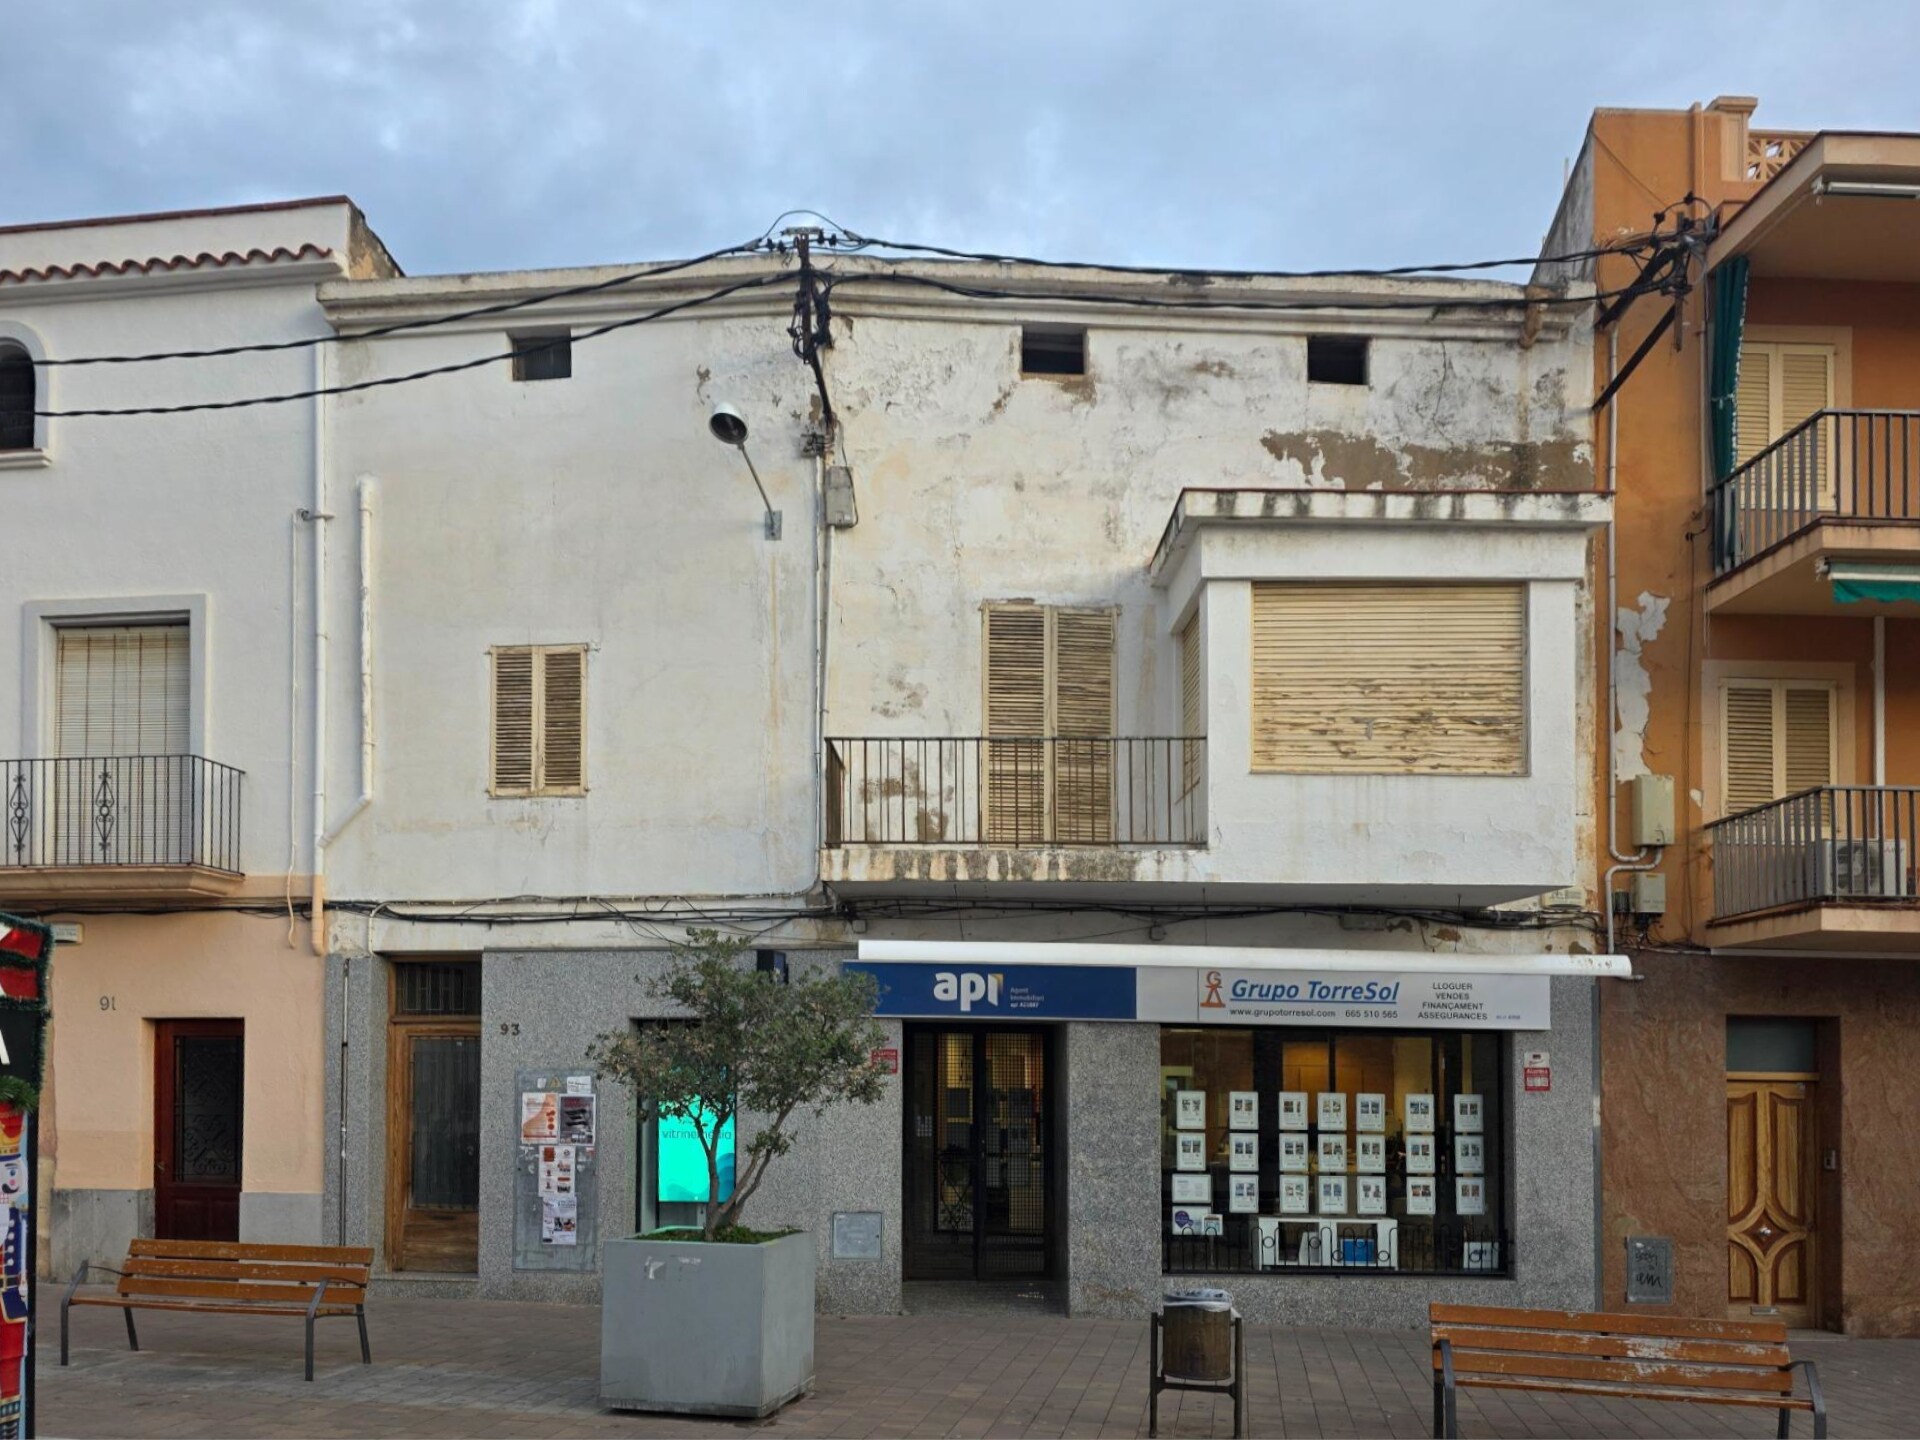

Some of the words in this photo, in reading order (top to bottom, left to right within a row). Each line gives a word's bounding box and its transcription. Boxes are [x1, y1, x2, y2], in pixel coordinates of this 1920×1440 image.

[1232, 979, 1299, 1001] Grupo
[1308, 981, 1400, 1000] TorreSol
[1432, 982, 1473, 990] LLOGUER
[933, 972, 1003, 1011] api
[1435, 992, 1470, 1000] VENDES
[99, 996, 116, 1011] 91
[1422, 1001, 1484, 1010] FINANÇAMENT
[1230, 1008, 1336, 1018] www.grupotorresol.com
[1345, 1009, 1361, 1018] 665
[1364, 1010, 1379, 1018] 510
[1382, 1010, 1398, 1018] 565
[1417, 1011, 1487, 1020] ASSEGURANCES
[500, 1022, 520, 1036] 93
